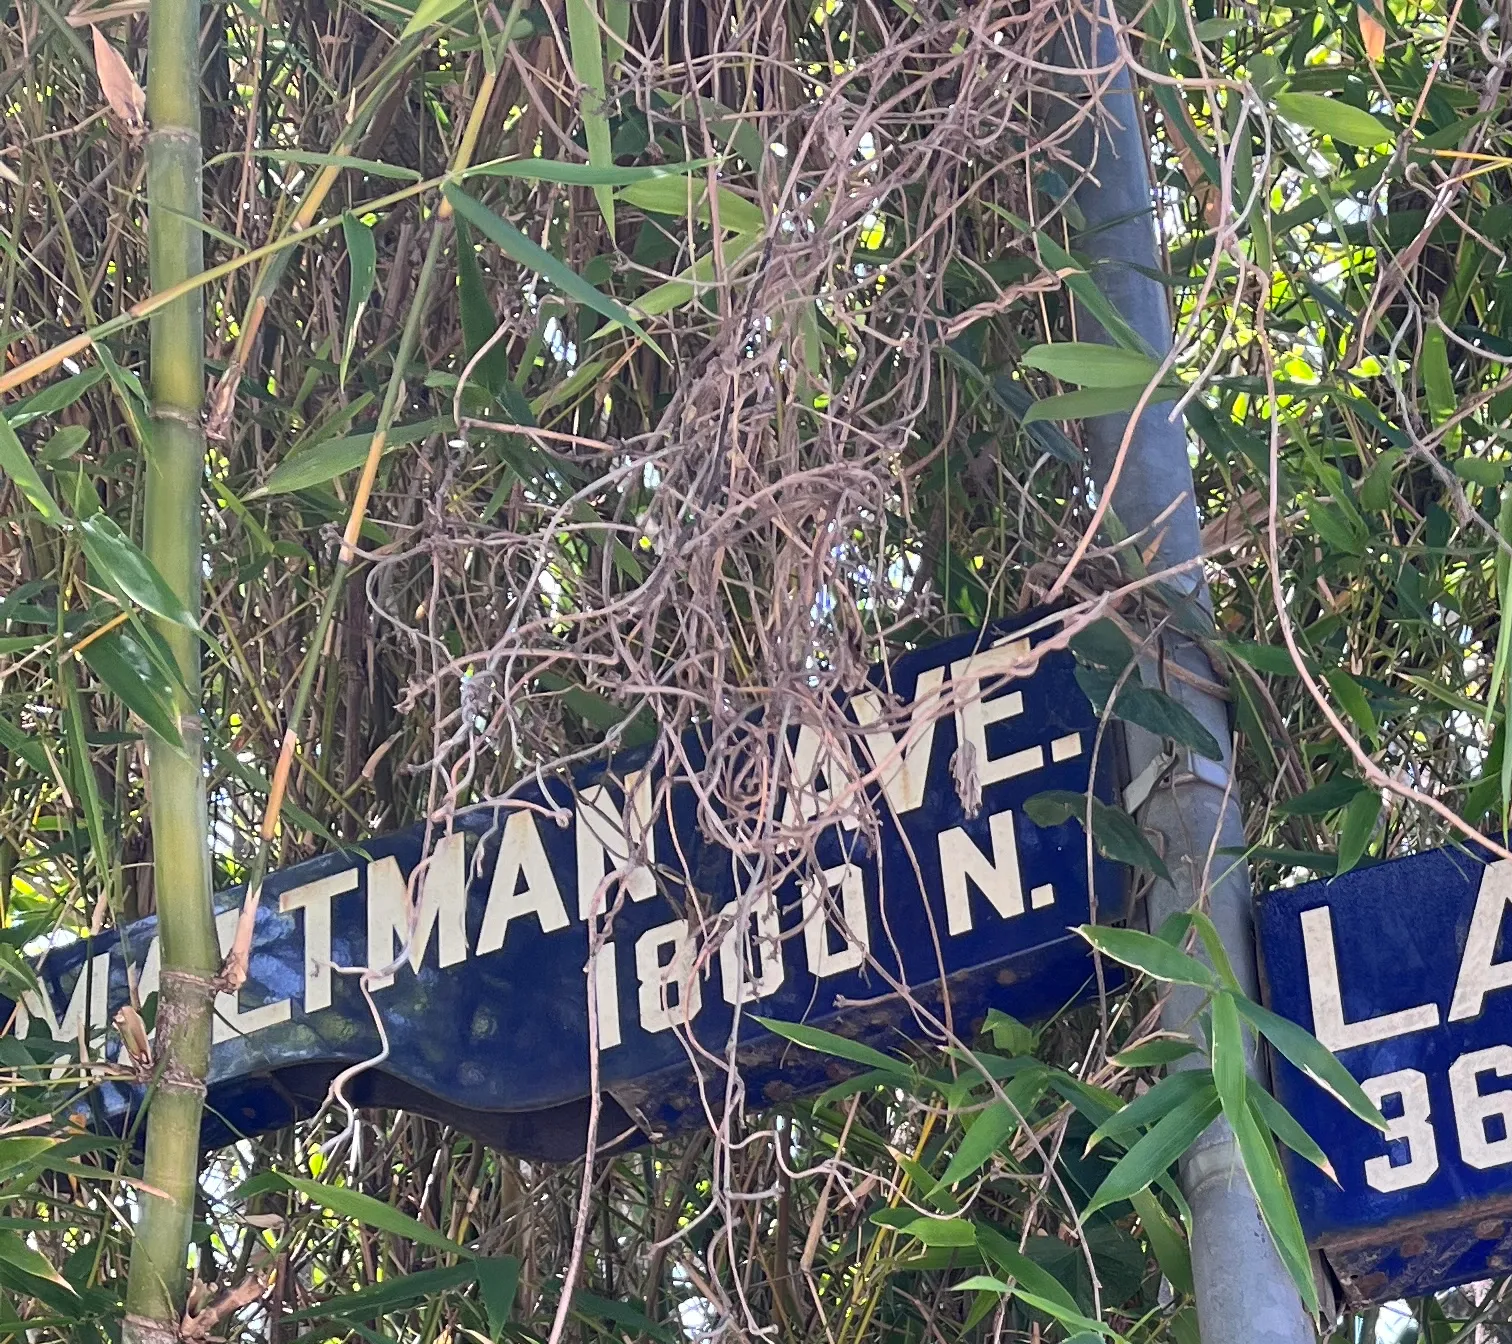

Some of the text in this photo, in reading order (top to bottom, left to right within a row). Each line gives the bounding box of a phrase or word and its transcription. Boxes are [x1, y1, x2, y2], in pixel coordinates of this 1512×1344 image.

[777, 637, 1082, 854] AVE.
[593, 810, 1055, 1050] 1800 N.
